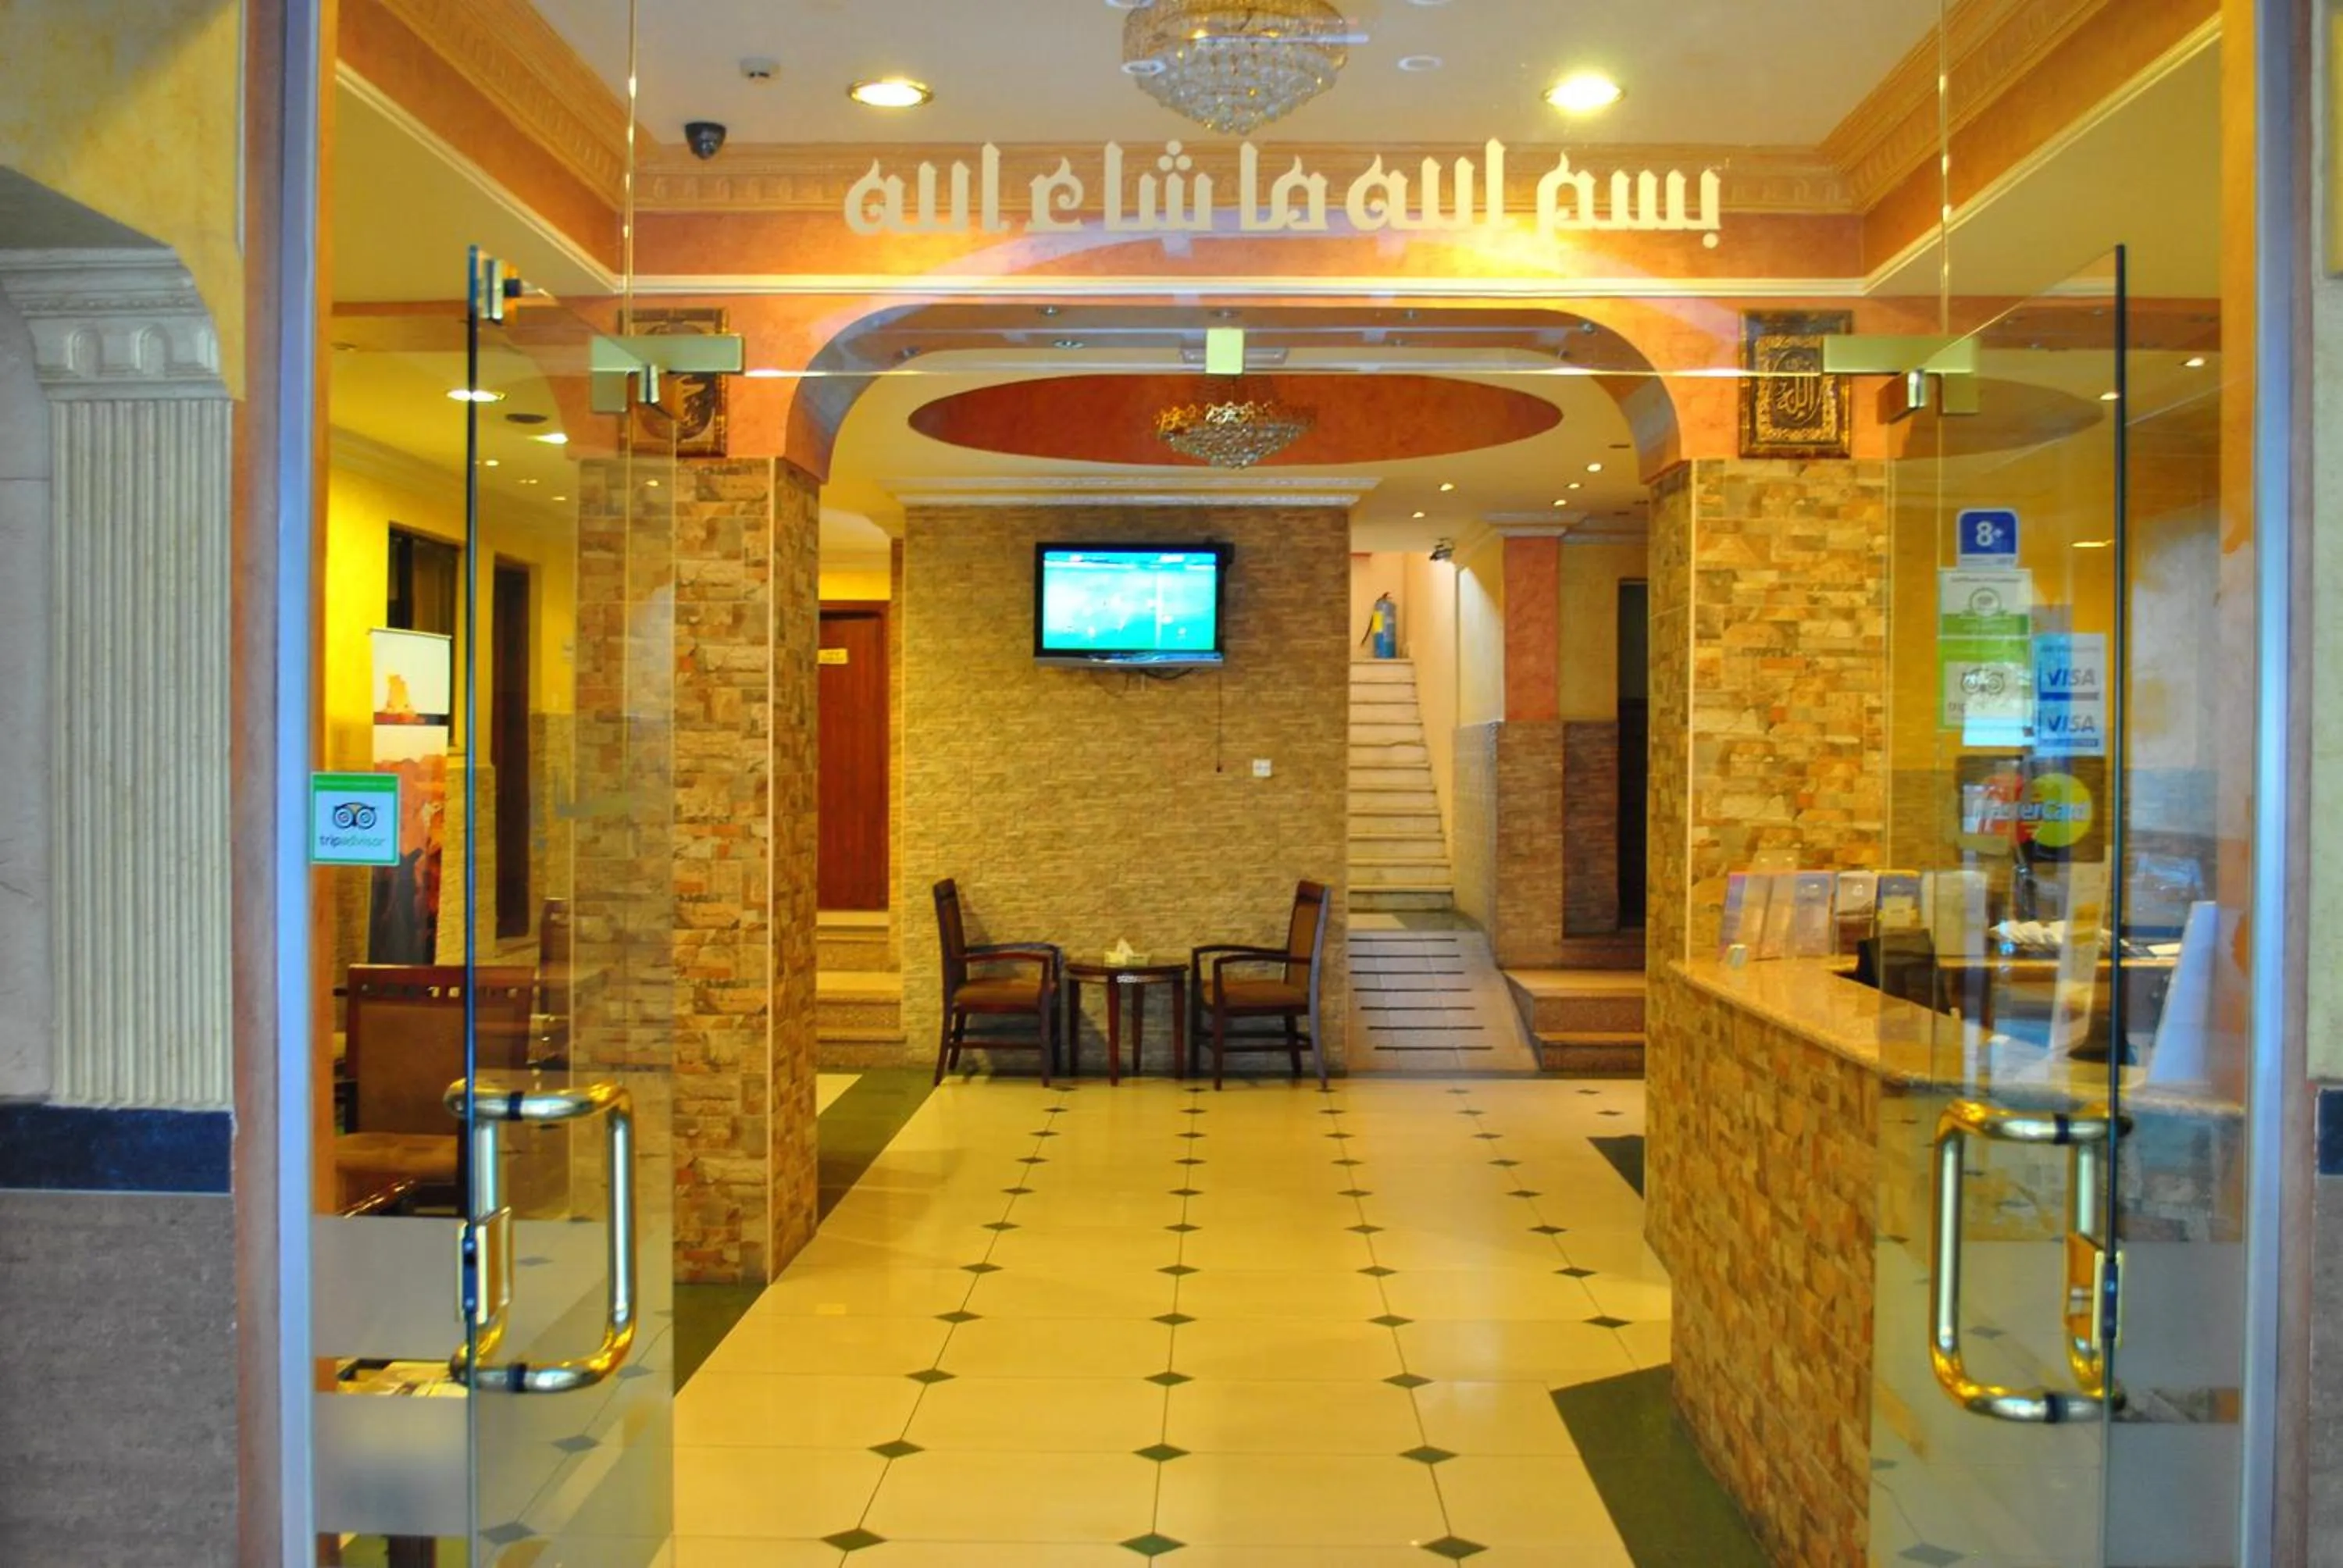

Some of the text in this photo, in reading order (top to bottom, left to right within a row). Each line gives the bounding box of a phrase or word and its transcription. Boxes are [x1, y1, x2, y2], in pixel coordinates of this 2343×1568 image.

[844, 137, 1721, 249] بسم الله ما شاء الله
[2046, 668, 2096, 686] VISA
[2047, 715, 2096, 733] VISA
